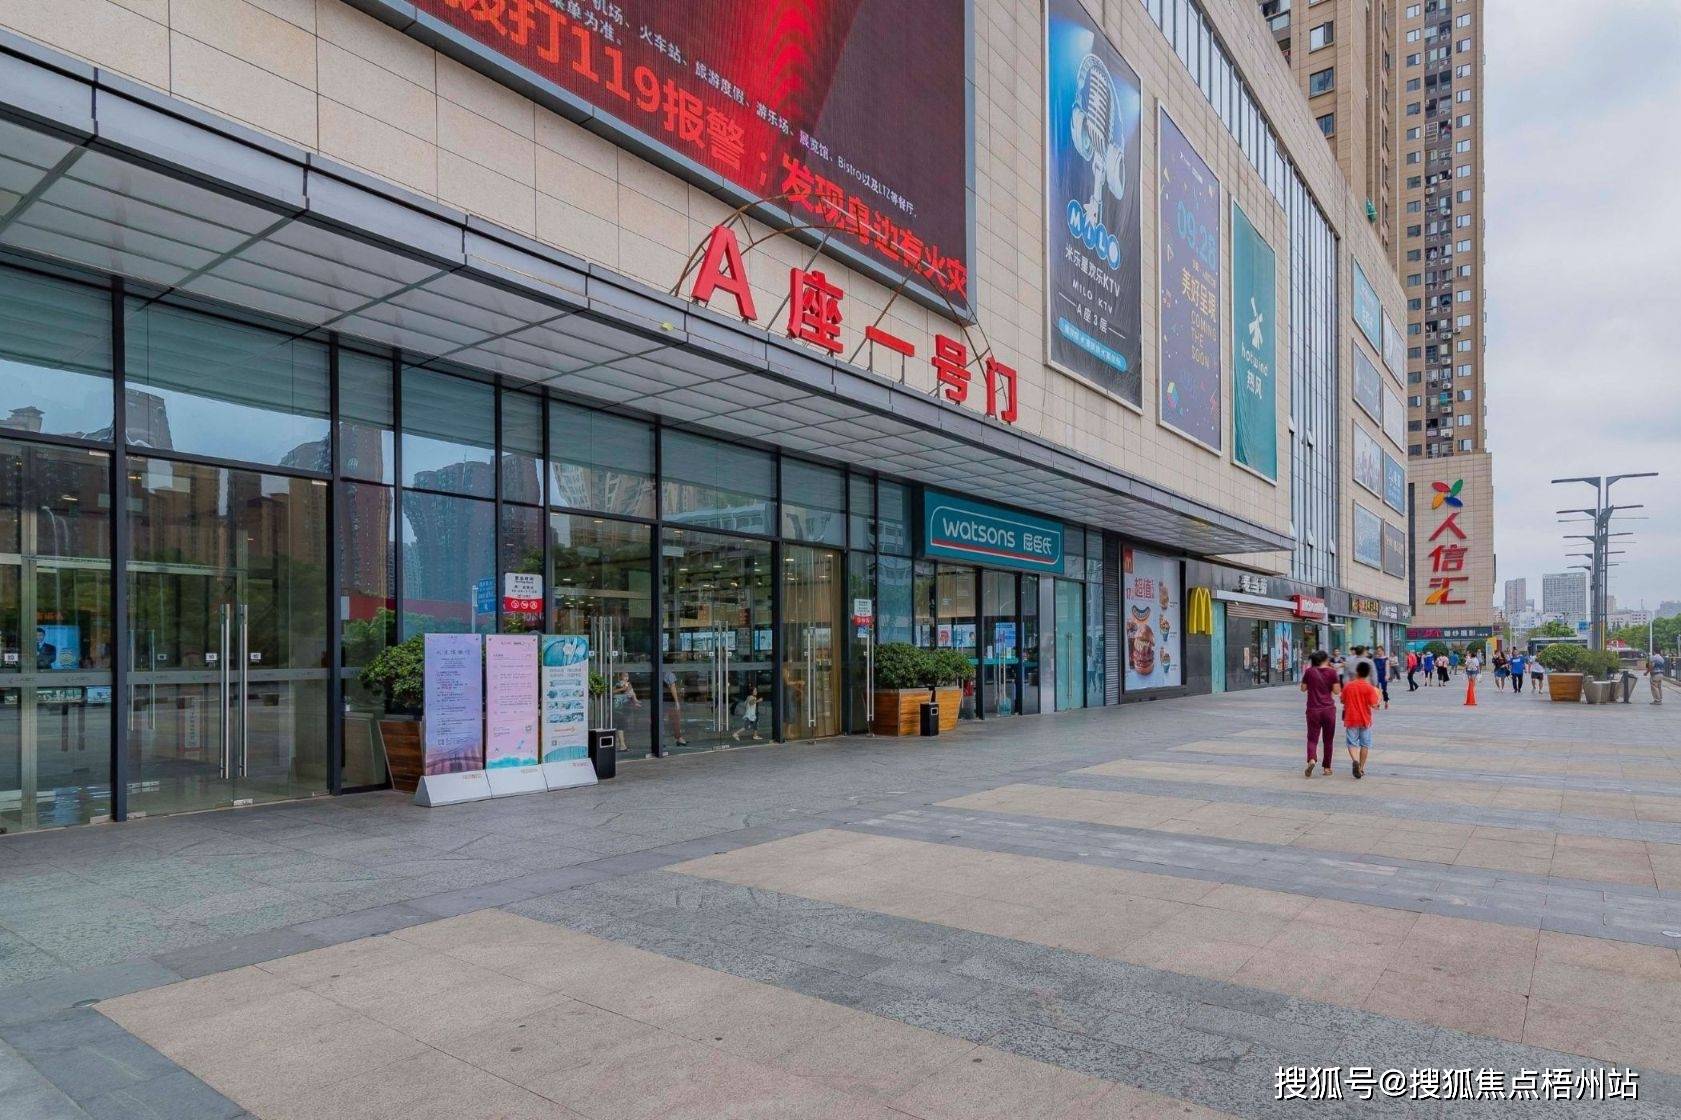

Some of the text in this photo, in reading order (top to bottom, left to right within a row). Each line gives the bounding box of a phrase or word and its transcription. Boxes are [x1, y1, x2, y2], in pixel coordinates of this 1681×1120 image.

[1065, 243, 1120, 297] 米乐星欢乐KTV
[1072, 279, 1113, 314] MILO KTV
[691, 225, 1018, 424] A座一号门
[1191, 310, 1217, 342] COMING
[943, 518, 1016, 548] watsons
[1023, 533, 1052, 555] 屈臣氏
[1425, 512, 1469, 605] 人信汇
